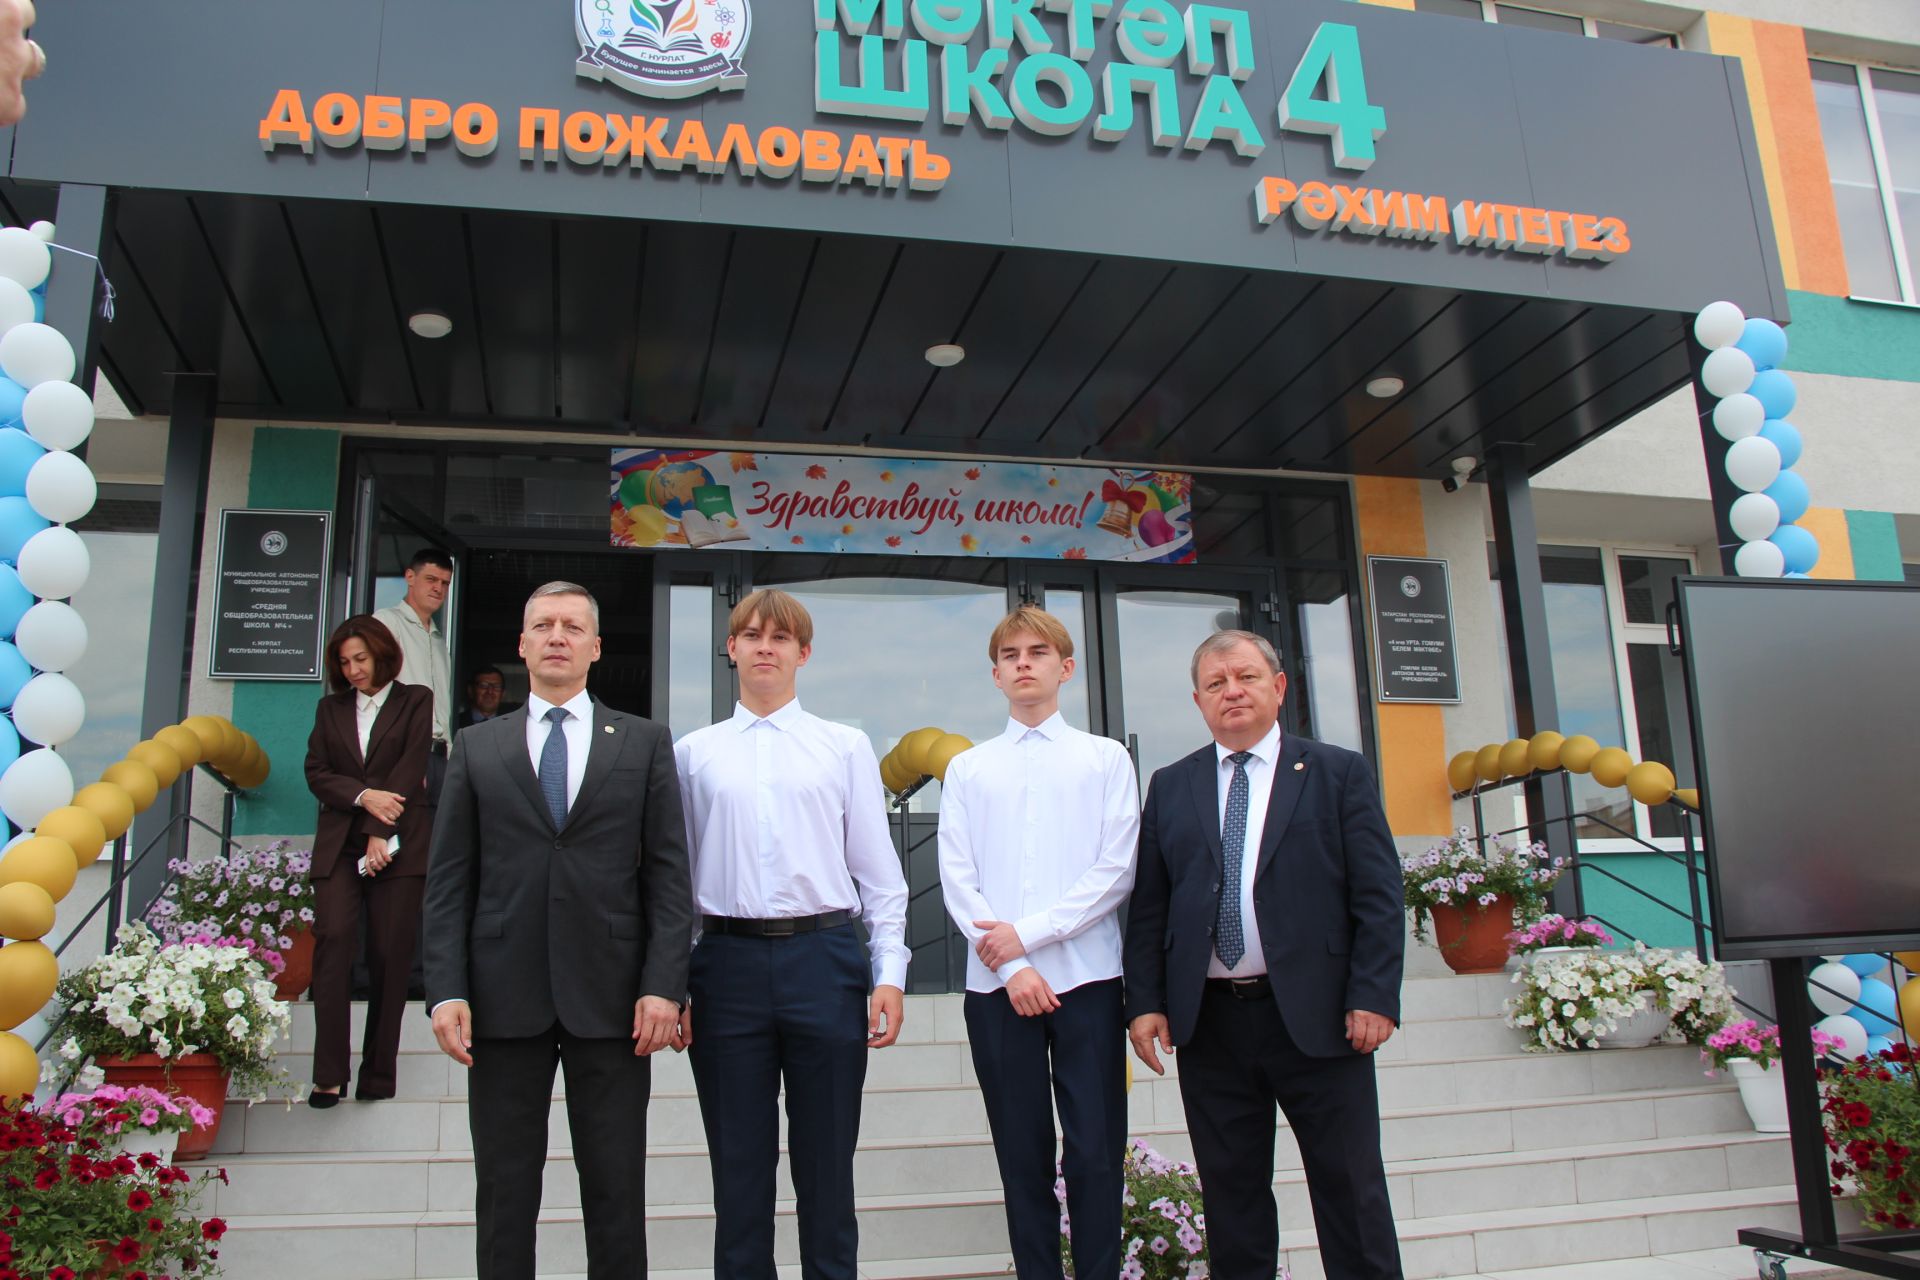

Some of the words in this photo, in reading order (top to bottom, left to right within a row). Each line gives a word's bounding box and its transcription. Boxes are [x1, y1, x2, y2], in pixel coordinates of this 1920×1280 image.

[600, 49, 639, 70] Будущее
[641, 66, 695, 76] начинается
[815, 30, 1266, 158] ШКОЛА
[1278, 21, 1387, 171] 4
[259, 89, 499, 158] ДОБРО
[518, 106, 951, 192] ПОЖАЛОВАТЬ
[1255, 176, 1450, 243] РӘХИМ
[1452, 200, 1631, 263] ИТЕГЕЗ
[745, 480, 963, 535] Здравствуй,
[973, 490, 1094, 530] школа!
